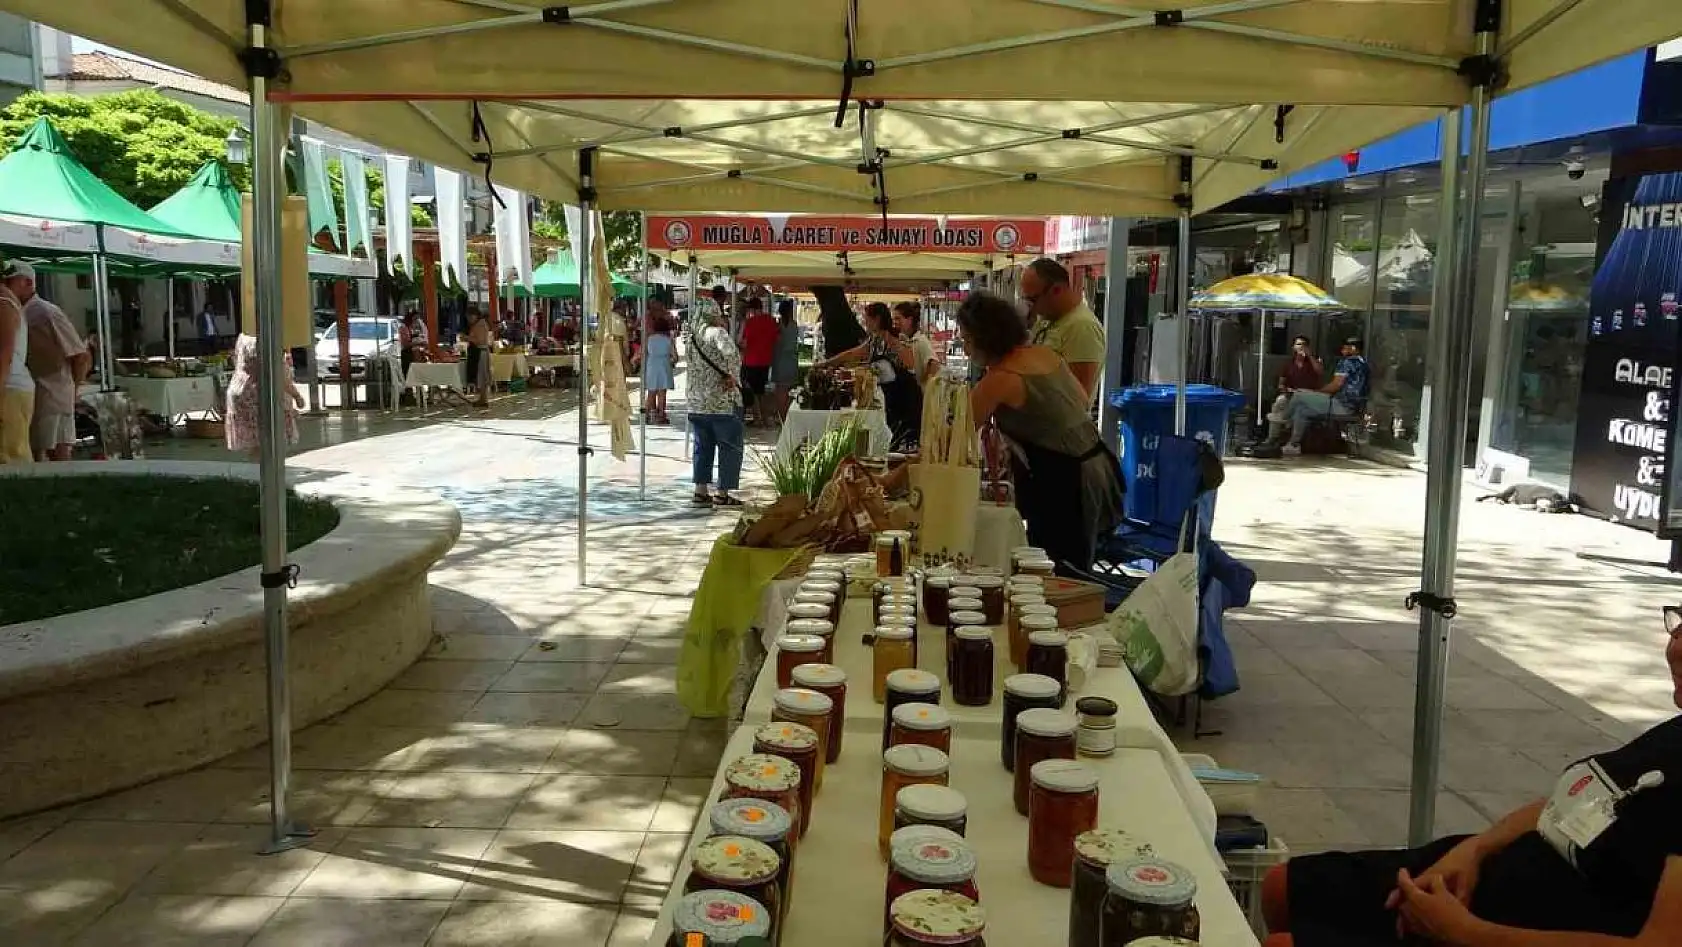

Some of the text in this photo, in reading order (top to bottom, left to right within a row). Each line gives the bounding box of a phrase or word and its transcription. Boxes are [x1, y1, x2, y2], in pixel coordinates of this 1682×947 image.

[703, 221, 763, 244] MUĞLA
[840, 229, 859, 245] ve
[933, 227, 983, 247] ODASI
